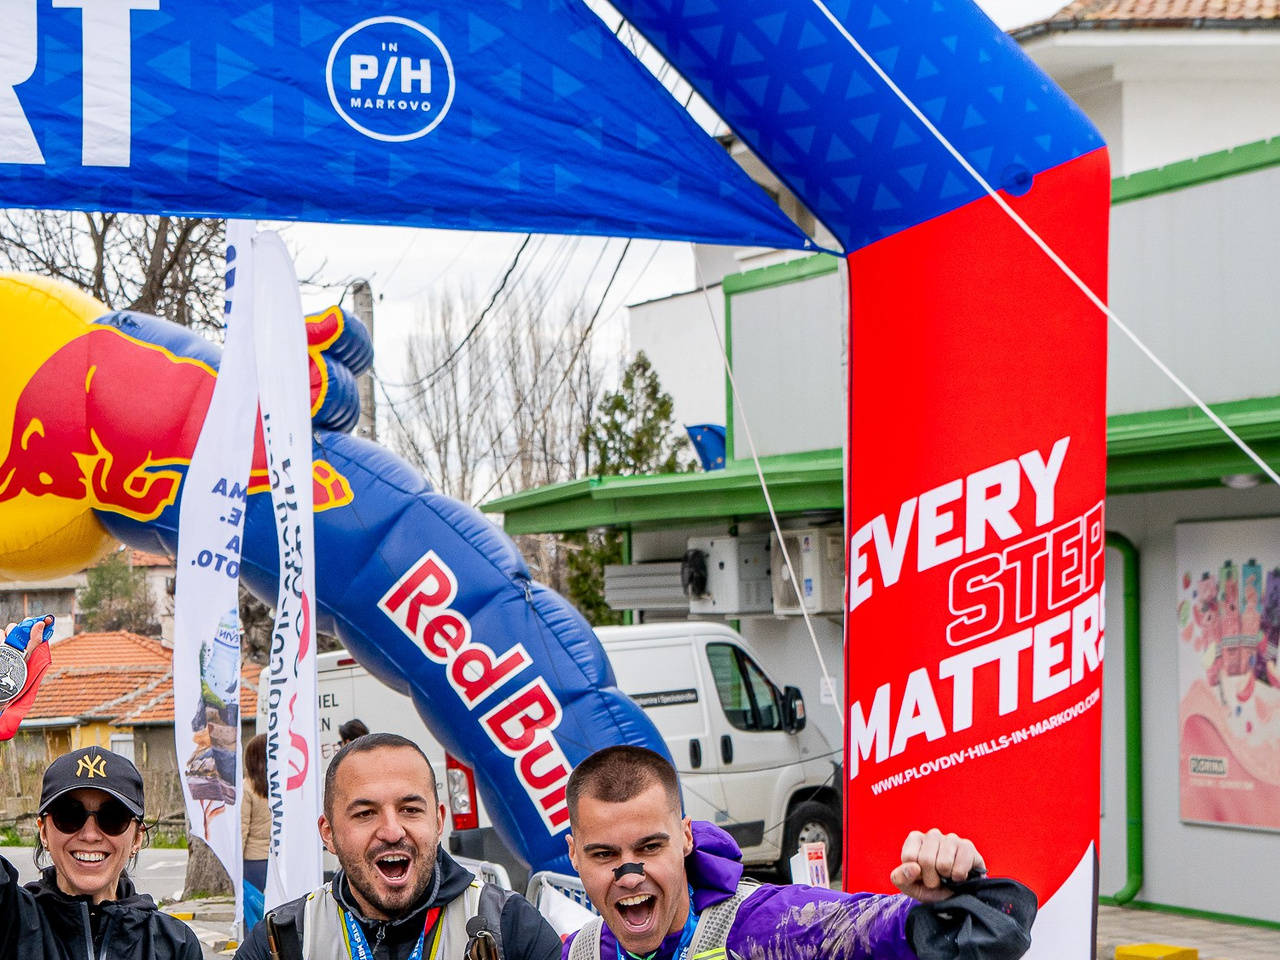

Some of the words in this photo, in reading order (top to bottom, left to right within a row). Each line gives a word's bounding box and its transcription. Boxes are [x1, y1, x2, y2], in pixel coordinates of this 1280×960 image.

[349, 53, 432, 96] P/H
[381, 41, 398, 53] IN
[349, 96, 432, 112] MARKOVO
[850, 435, 1071, 614] EVERY
[945, 499, 1105, 647] STEP
[381, 553, 529, 706] Red
[75, 754, 108, 778] NY
[870, 686, 1101, 796] WWW.PLOVDIV-HILLS-IN-MARKOVO.COM
